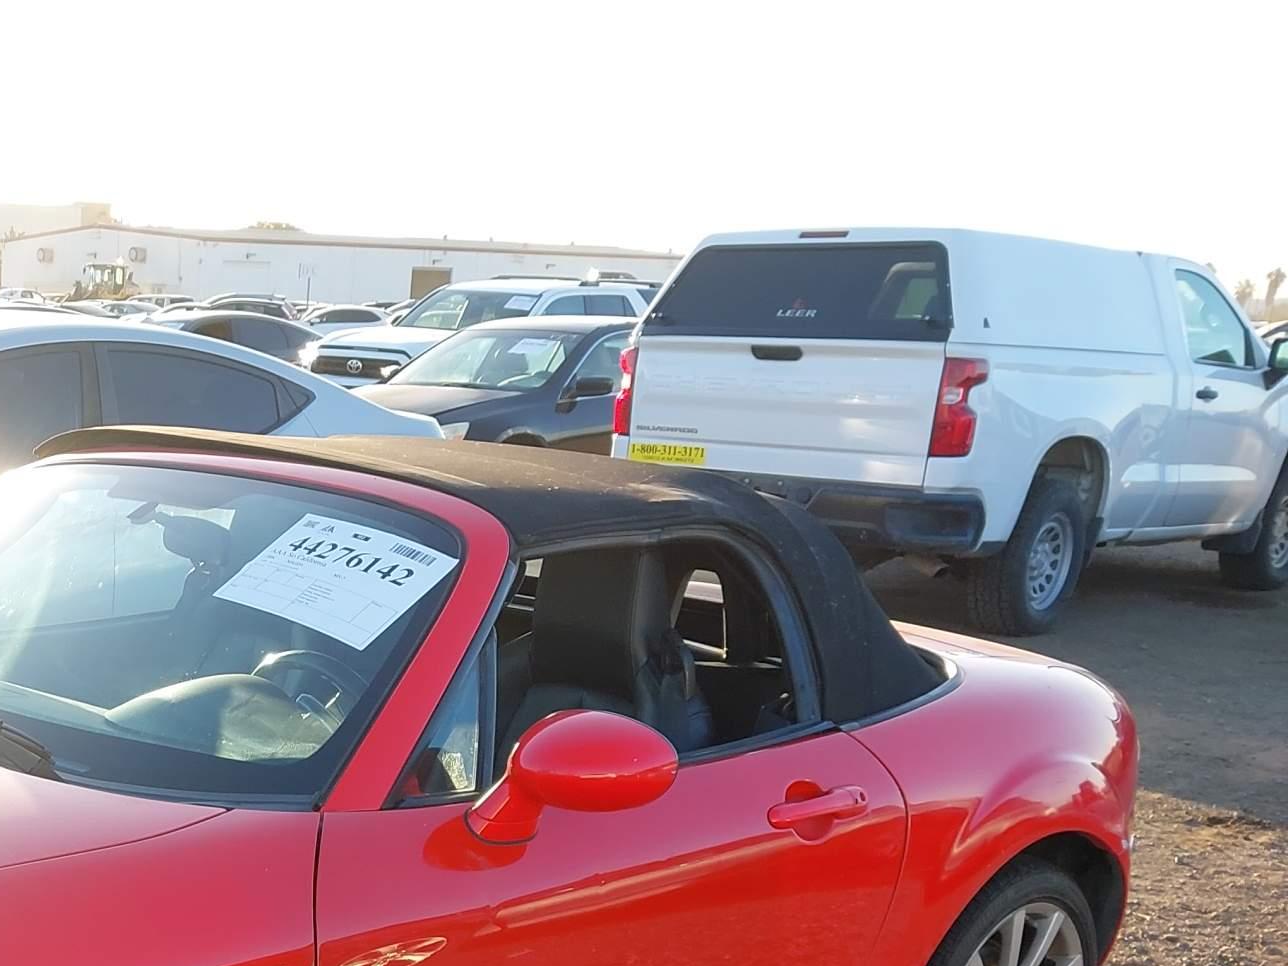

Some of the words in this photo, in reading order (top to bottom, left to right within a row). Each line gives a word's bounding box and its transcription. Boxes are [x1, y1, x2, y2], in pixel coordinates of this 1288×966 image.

[776, 309, 817, 318] LEER
[631, 443, 705, 458] 1-800-311-3171
[289, 536, 414, 587] 44276142
